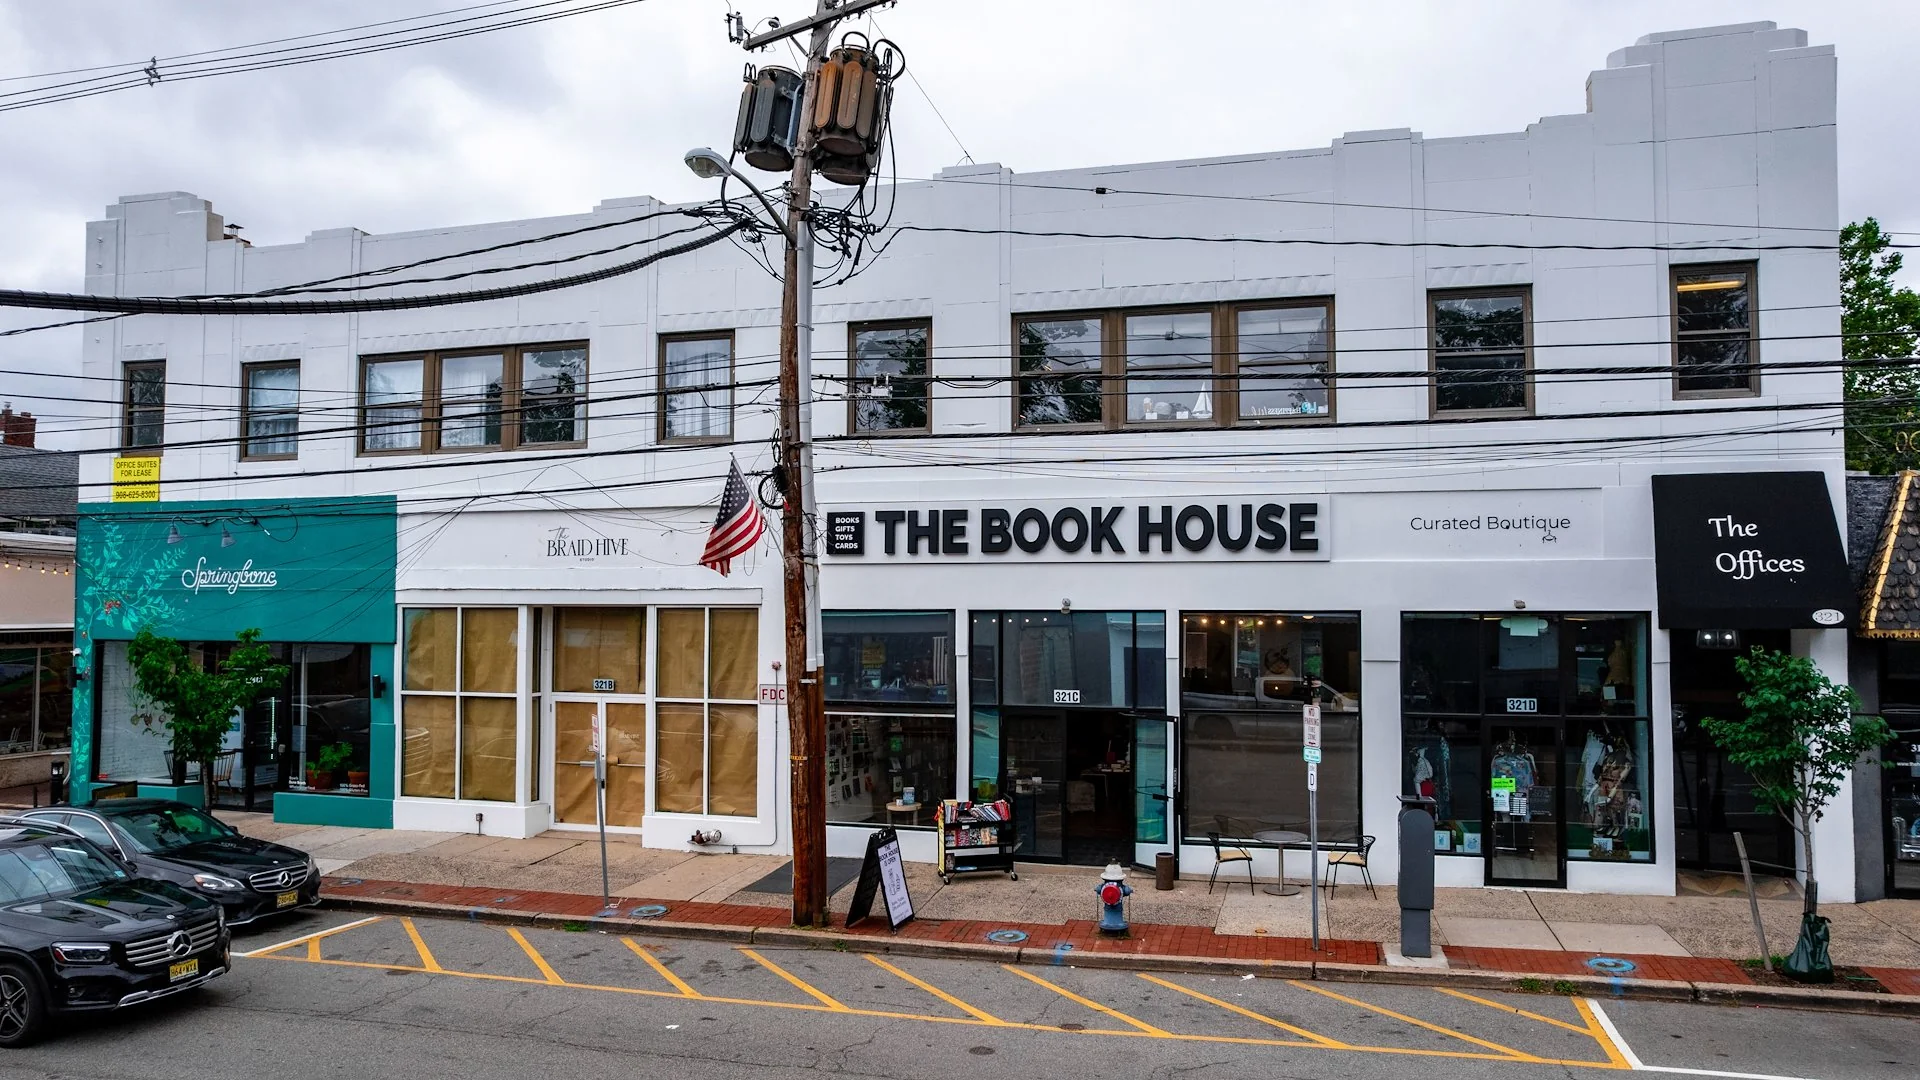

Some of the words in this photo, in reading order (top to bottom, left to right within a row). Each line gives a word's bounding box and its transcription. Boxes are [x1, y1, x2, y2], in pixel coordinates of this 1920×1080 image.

[116, 461, 136, 469] OFFICE
[137, 460, 157, 468] SUITES
[875, 509, 970, 556] THE
[981, 507, 1125, 554] BOOK
[1138, 503, 1319, 553] HOUSE
[1410, 515, 1481, 530] Curated
[1487, 515, 1571, 532] Boutique
[1708, 515, 1759, 537] The
[548, 526, 570, 541] The
[547, 539, 593, 556] BRAID
[596, 539, 629, 556] HIVE
[1715, 550, 1805, 580] Offices
[181, 556, 277, 595] Springbone
[1814, 611, 1841, 622] 321
[594, 680, 613, 690] 321B
[762, 688, 785, 701] FDC
[1055, 691, 1079, 702] 321C
[1508, 699, 1536, 711] 321D
